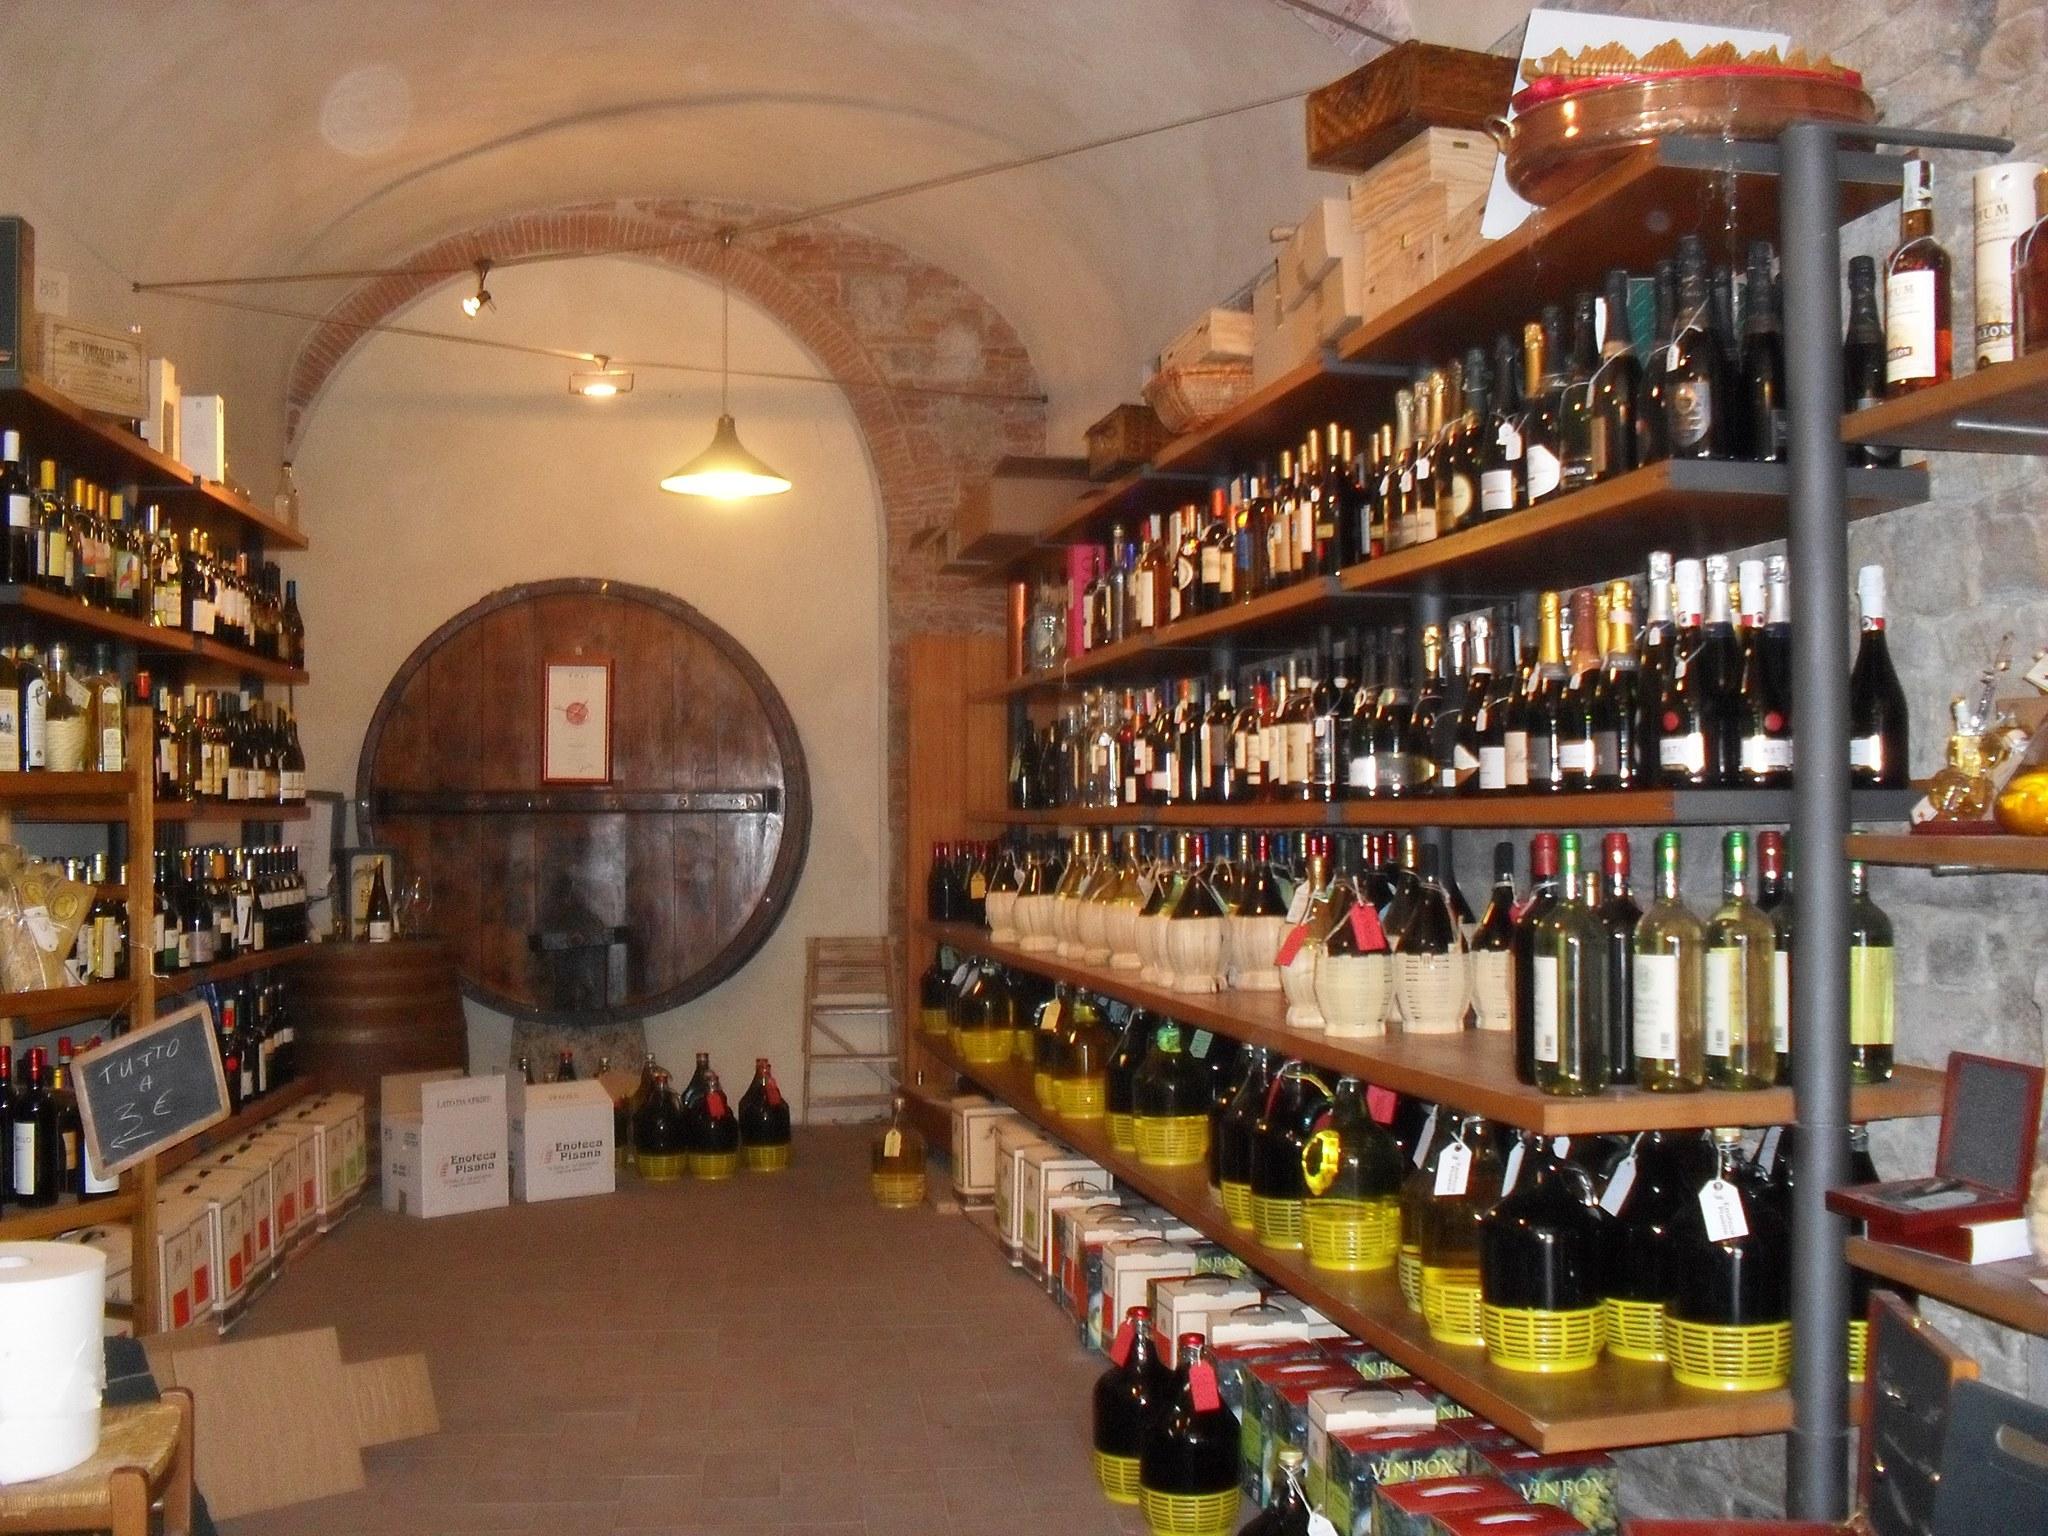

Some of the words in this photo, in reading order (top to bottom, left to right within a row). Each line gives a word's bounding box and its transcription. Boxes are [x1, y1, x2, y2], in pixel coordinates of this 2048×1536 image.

[98, 1038, 179, 1084] TUTTO
[140, 1074, 153, 1093] A
[153, 1088, 173, 1116] €
[555, 1139, 603, 1153] Enoteca
[560, 1149, 601, 1162] Pisana
[450, 1151, 497, 1166] Enoteca
[455, 1161, 495, 1175] Pisana
[1370, 1458, 1460, 1483] VINBOX
[1520, 1477, 1609, 1502] VINBOX
